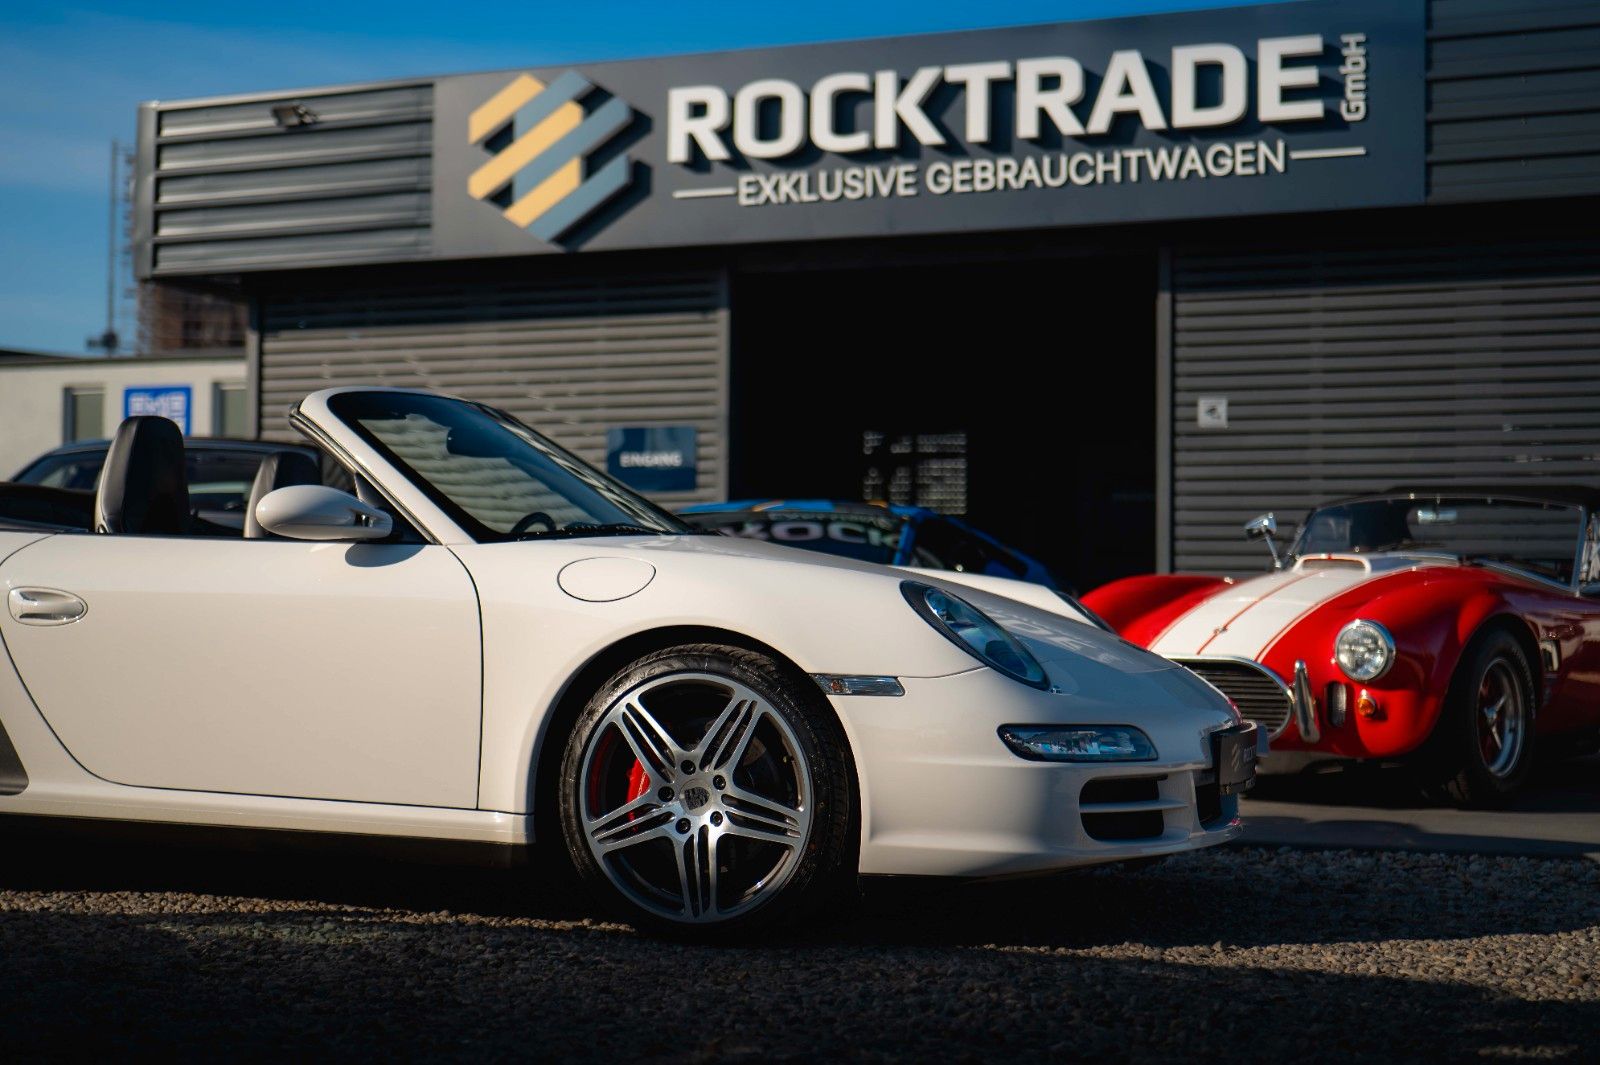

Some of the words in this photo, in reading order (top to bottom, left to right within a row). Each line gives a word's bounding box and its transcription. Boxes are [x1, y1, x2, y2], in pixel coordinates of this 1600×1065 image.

[666, 35, 1324, 164] ROCKTRADE
[1340, 33, 1366, 121] GmbH
[737, 163, 917, 207] EXKLUSIVE
[925, 139, 1286, 195] GEBRAUCHTWAGEN
